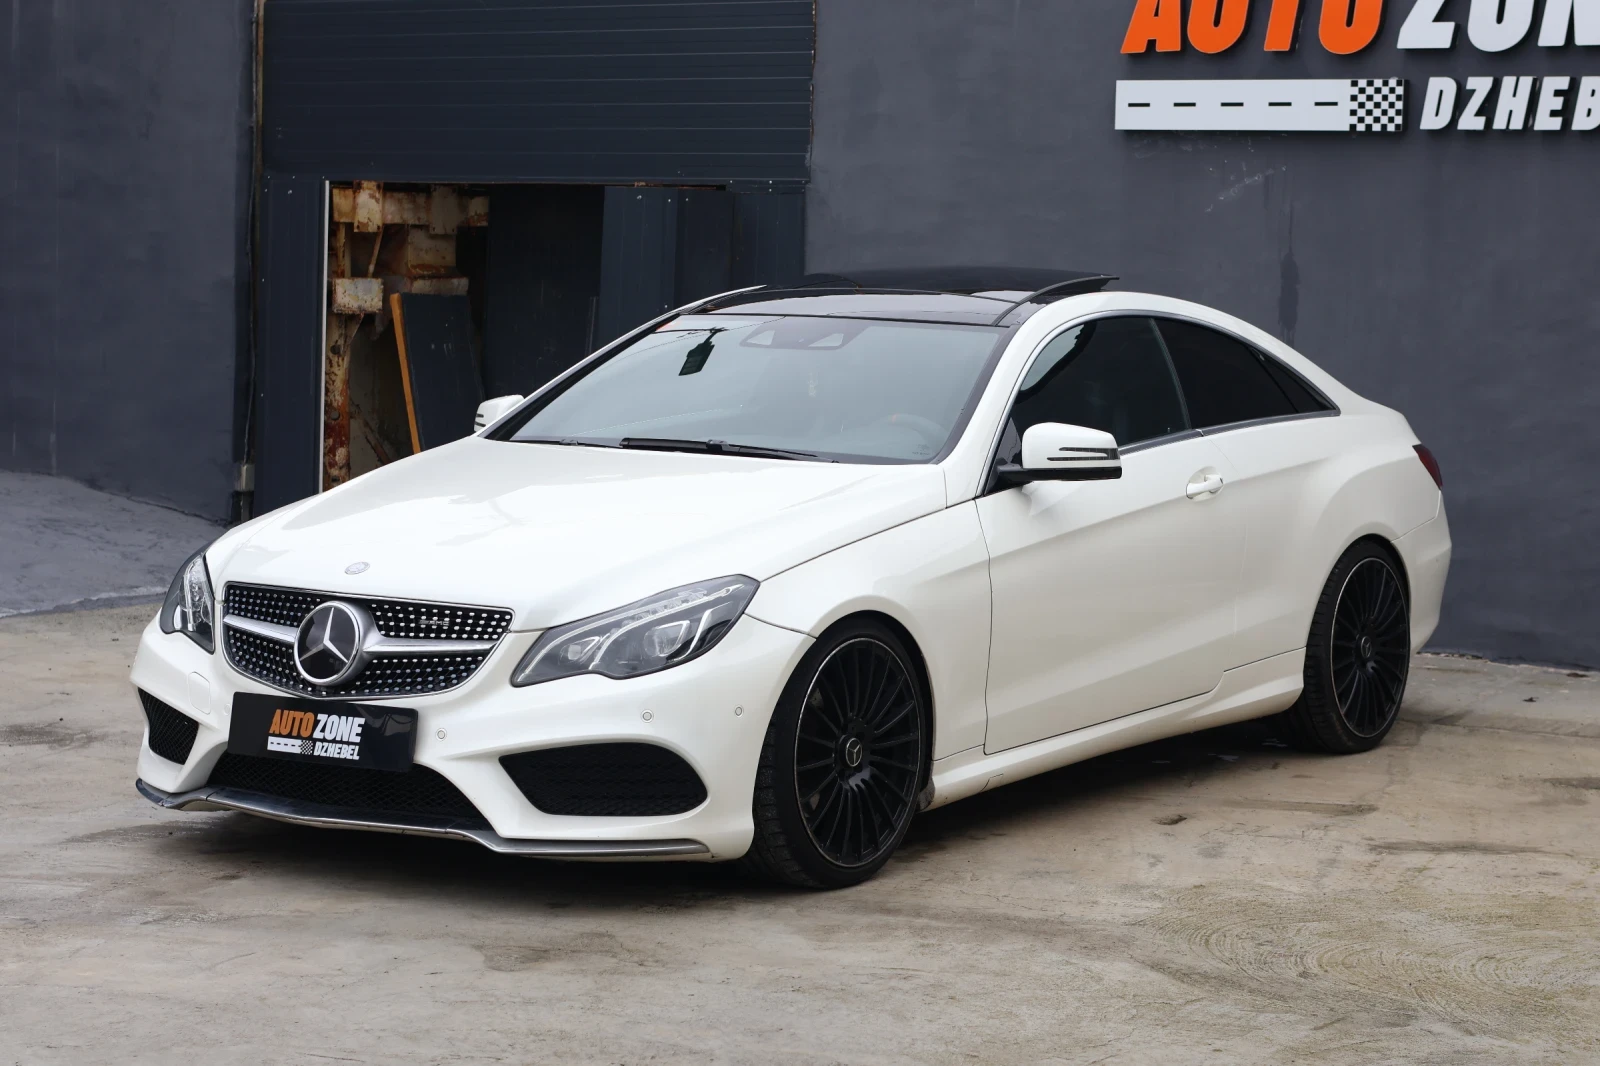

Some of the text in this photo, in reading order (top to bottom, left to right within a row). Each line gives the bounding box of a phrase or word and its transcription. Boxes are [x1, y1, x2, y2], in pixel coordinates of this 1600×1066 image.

[269, 708, 366, 743] AUTO ZONE
[313, 741, 360, 760] DZHEBEL
